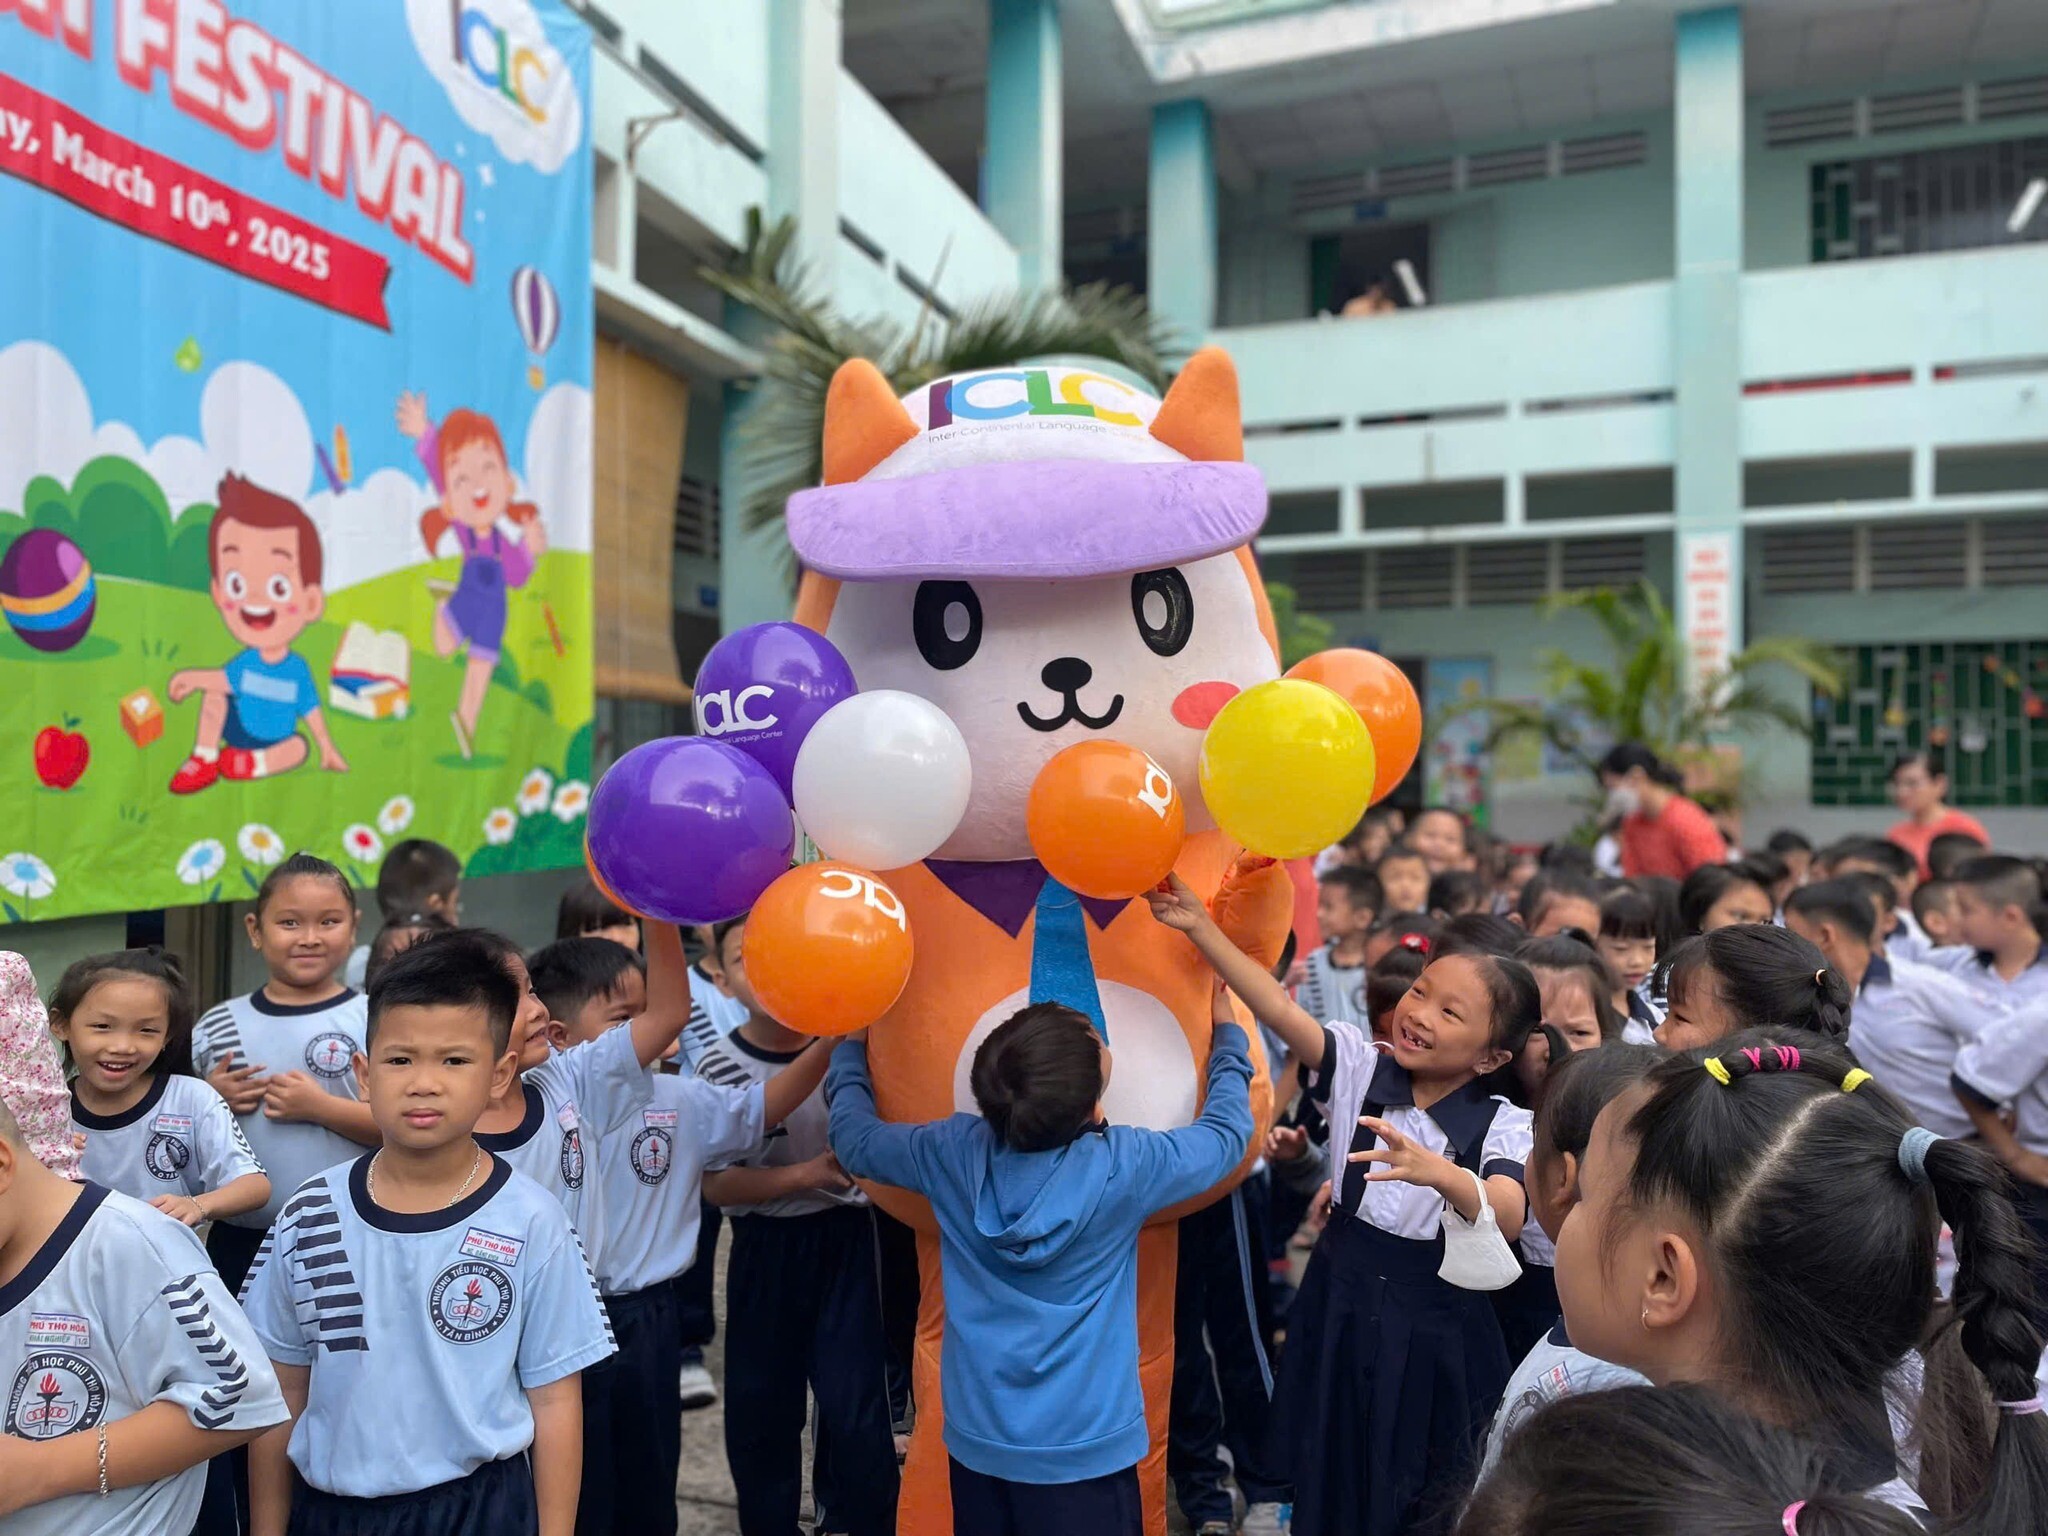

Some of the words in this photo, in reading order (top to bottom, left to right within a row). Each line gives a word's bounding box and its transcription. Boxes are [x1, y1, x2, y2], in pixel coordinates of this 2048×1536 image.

[116, 0, 474, 285] FESTIVAL
[51, 121, 155, 208] March
[248, 217, 331, 280] 2025
[928, 369, 1144, 431] ICLC
[929, 430, 956, 444] Inter
[960, 420, 1036, 437] Continental
[1038, 420, 1106, 434] Language
[761, 730, 783, 739] Center
[472, 1265, 490, 1276] HỌC
[42, 1357, 64, 1368] HỌC
[66, 1359, 90, 1375] PHÚ
[85, 1374, 101, 1392] THỌ
[87, 1394, 101, 1413] HÒA
